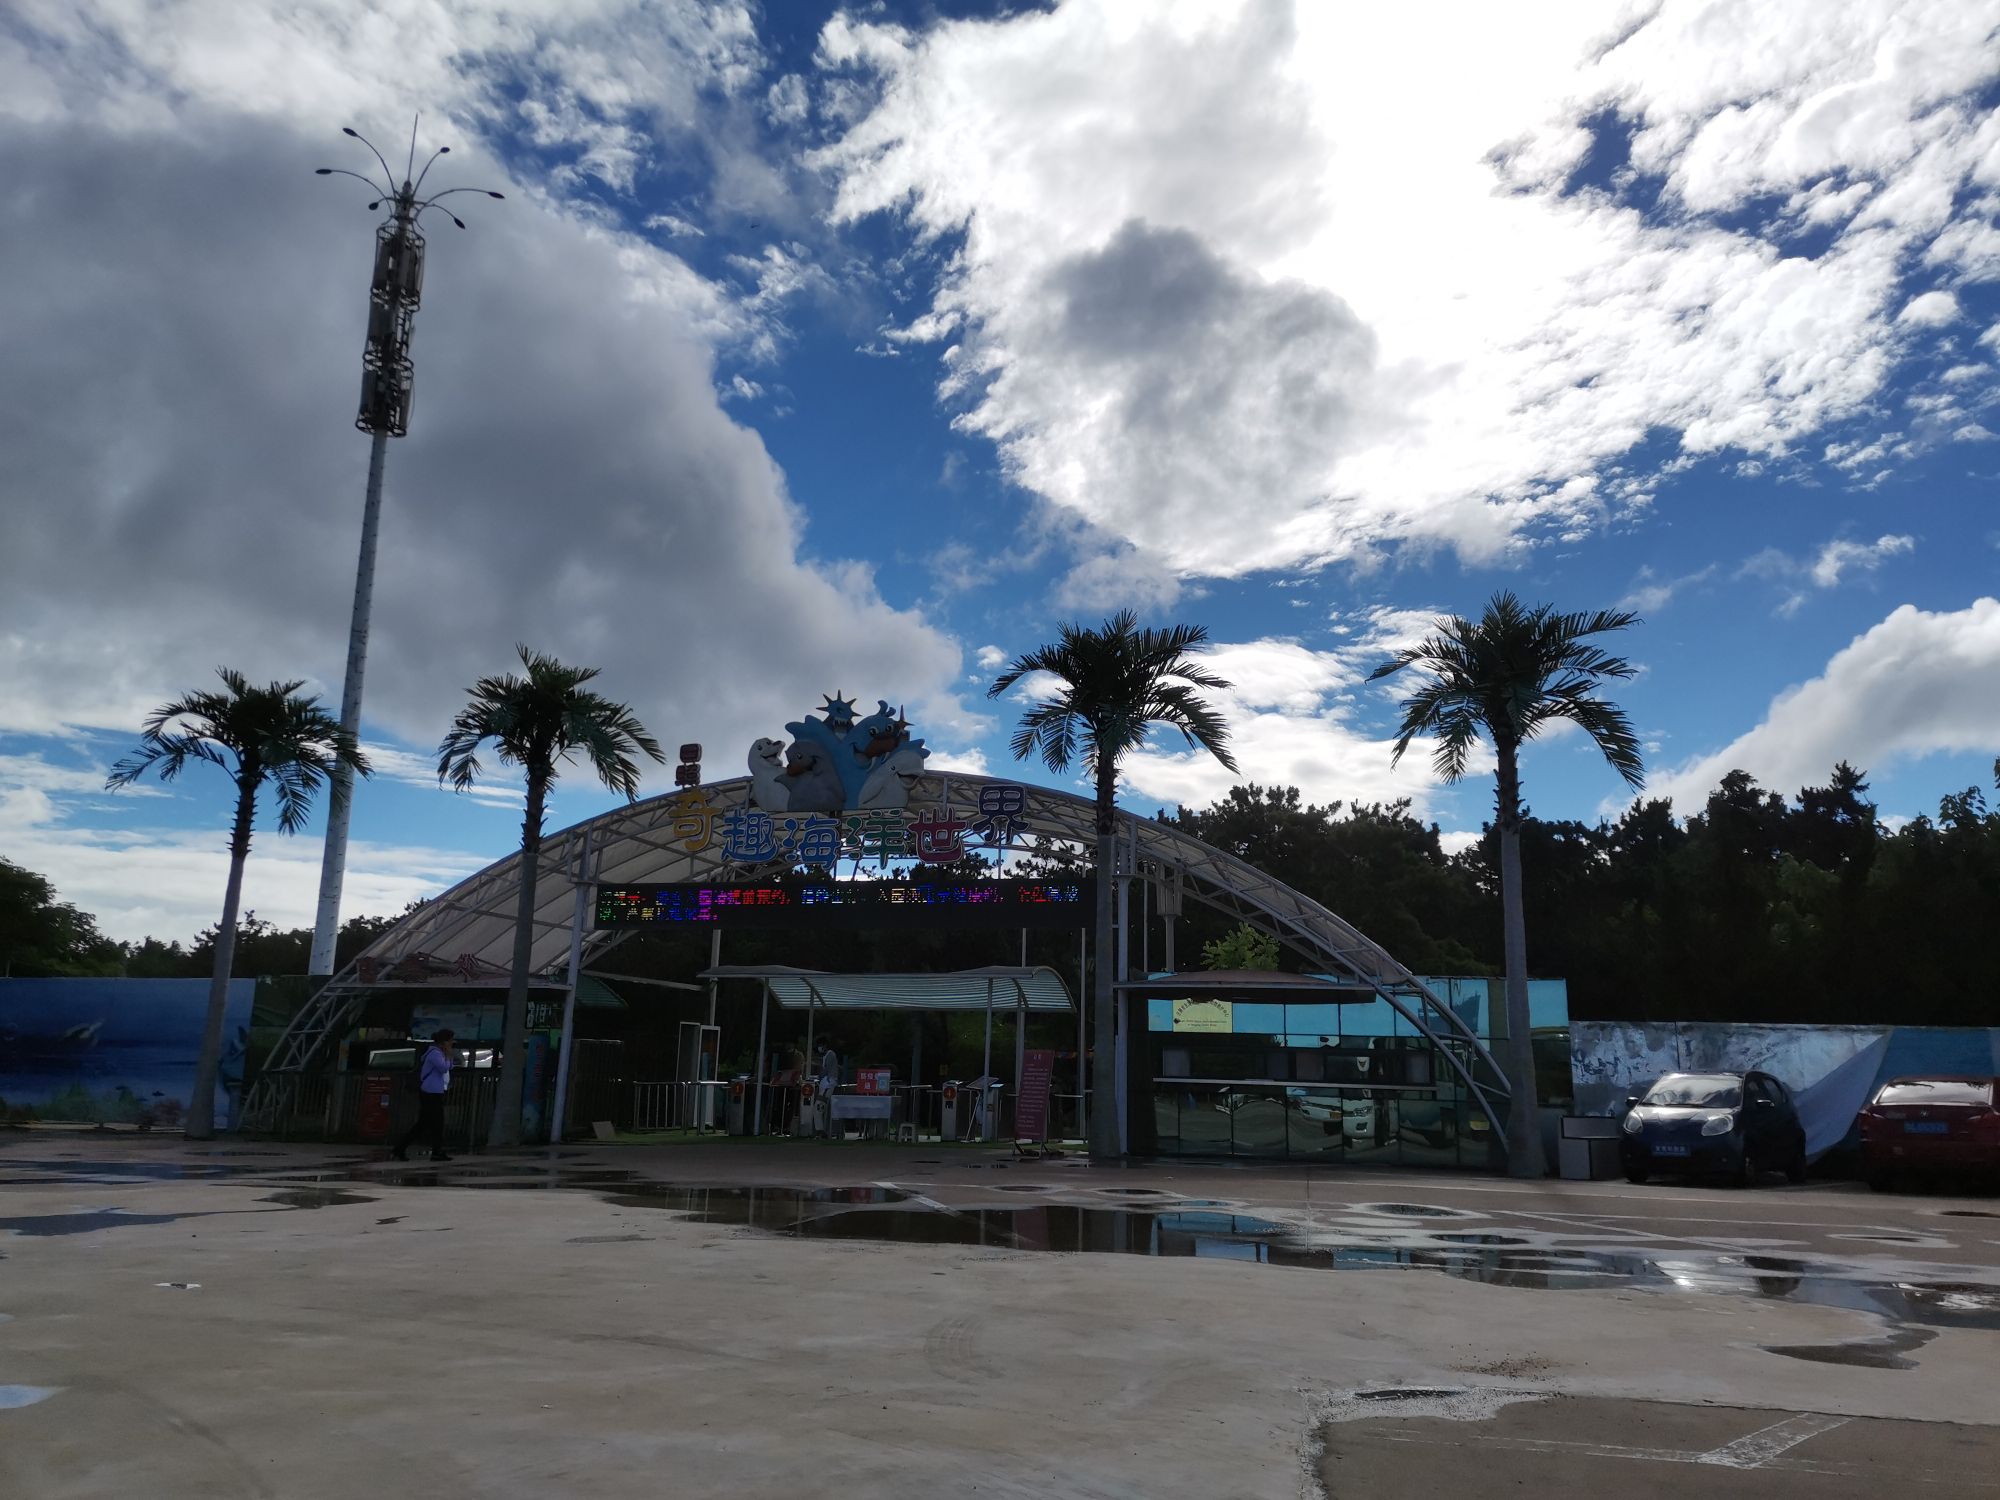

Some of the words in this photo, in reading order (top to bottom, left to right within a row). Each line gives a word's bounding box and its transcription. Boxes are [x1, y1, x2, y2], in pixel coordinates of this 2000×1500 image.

[667, 785, 1030, 871] 奇趣海洋世界
